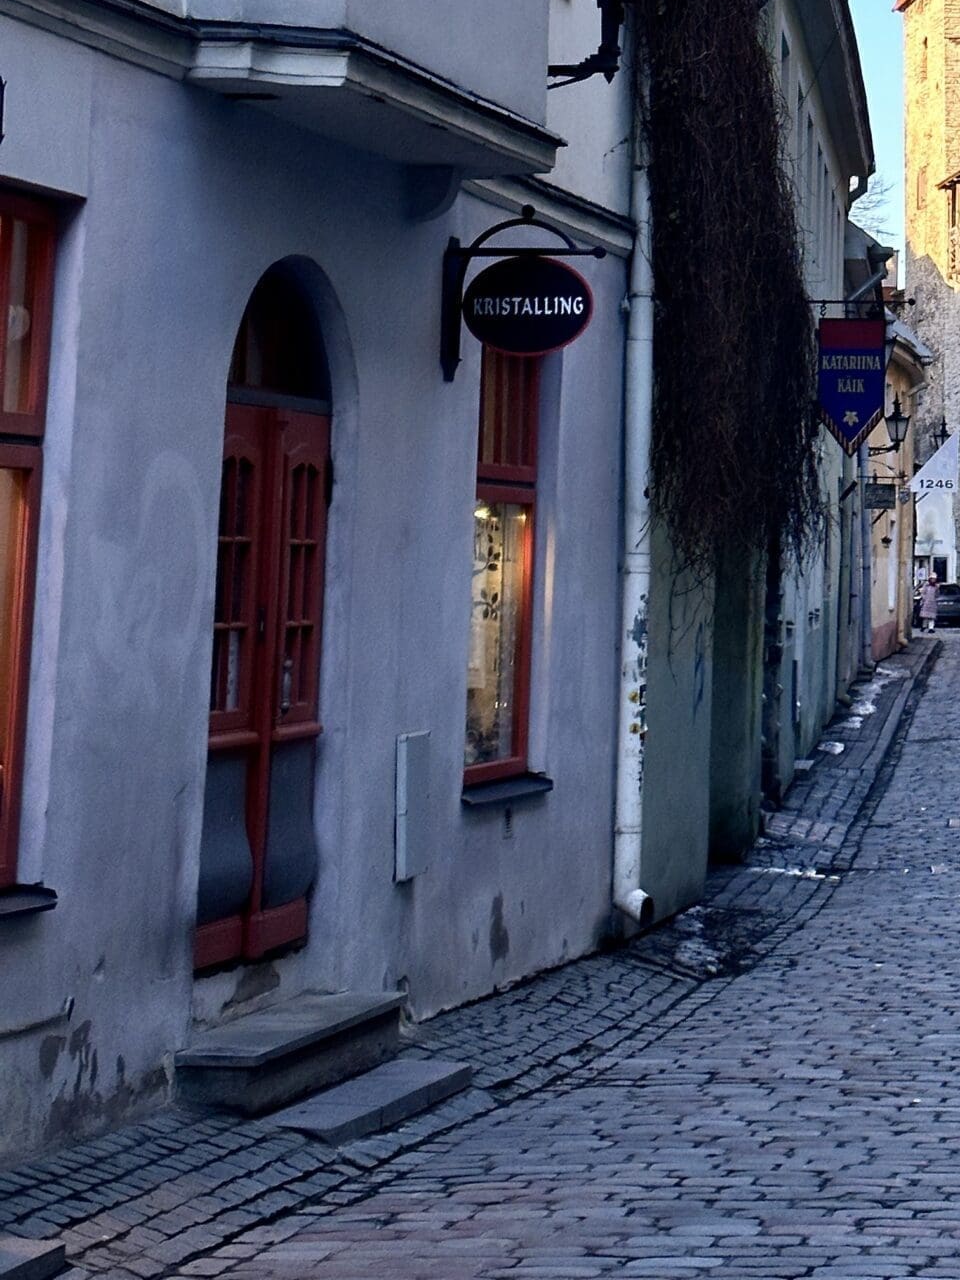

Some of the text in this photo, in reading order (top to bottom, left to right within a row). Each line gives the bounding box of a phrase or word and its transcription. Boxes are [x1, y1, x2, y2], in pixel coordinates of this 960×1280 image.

[474, 297, 584, 315] KRISTALLING
[822, 355, 881, 370] KATARIINA
[837, 376, 865, 393] KÄIK
[920, 479, 954, 489] 1246
